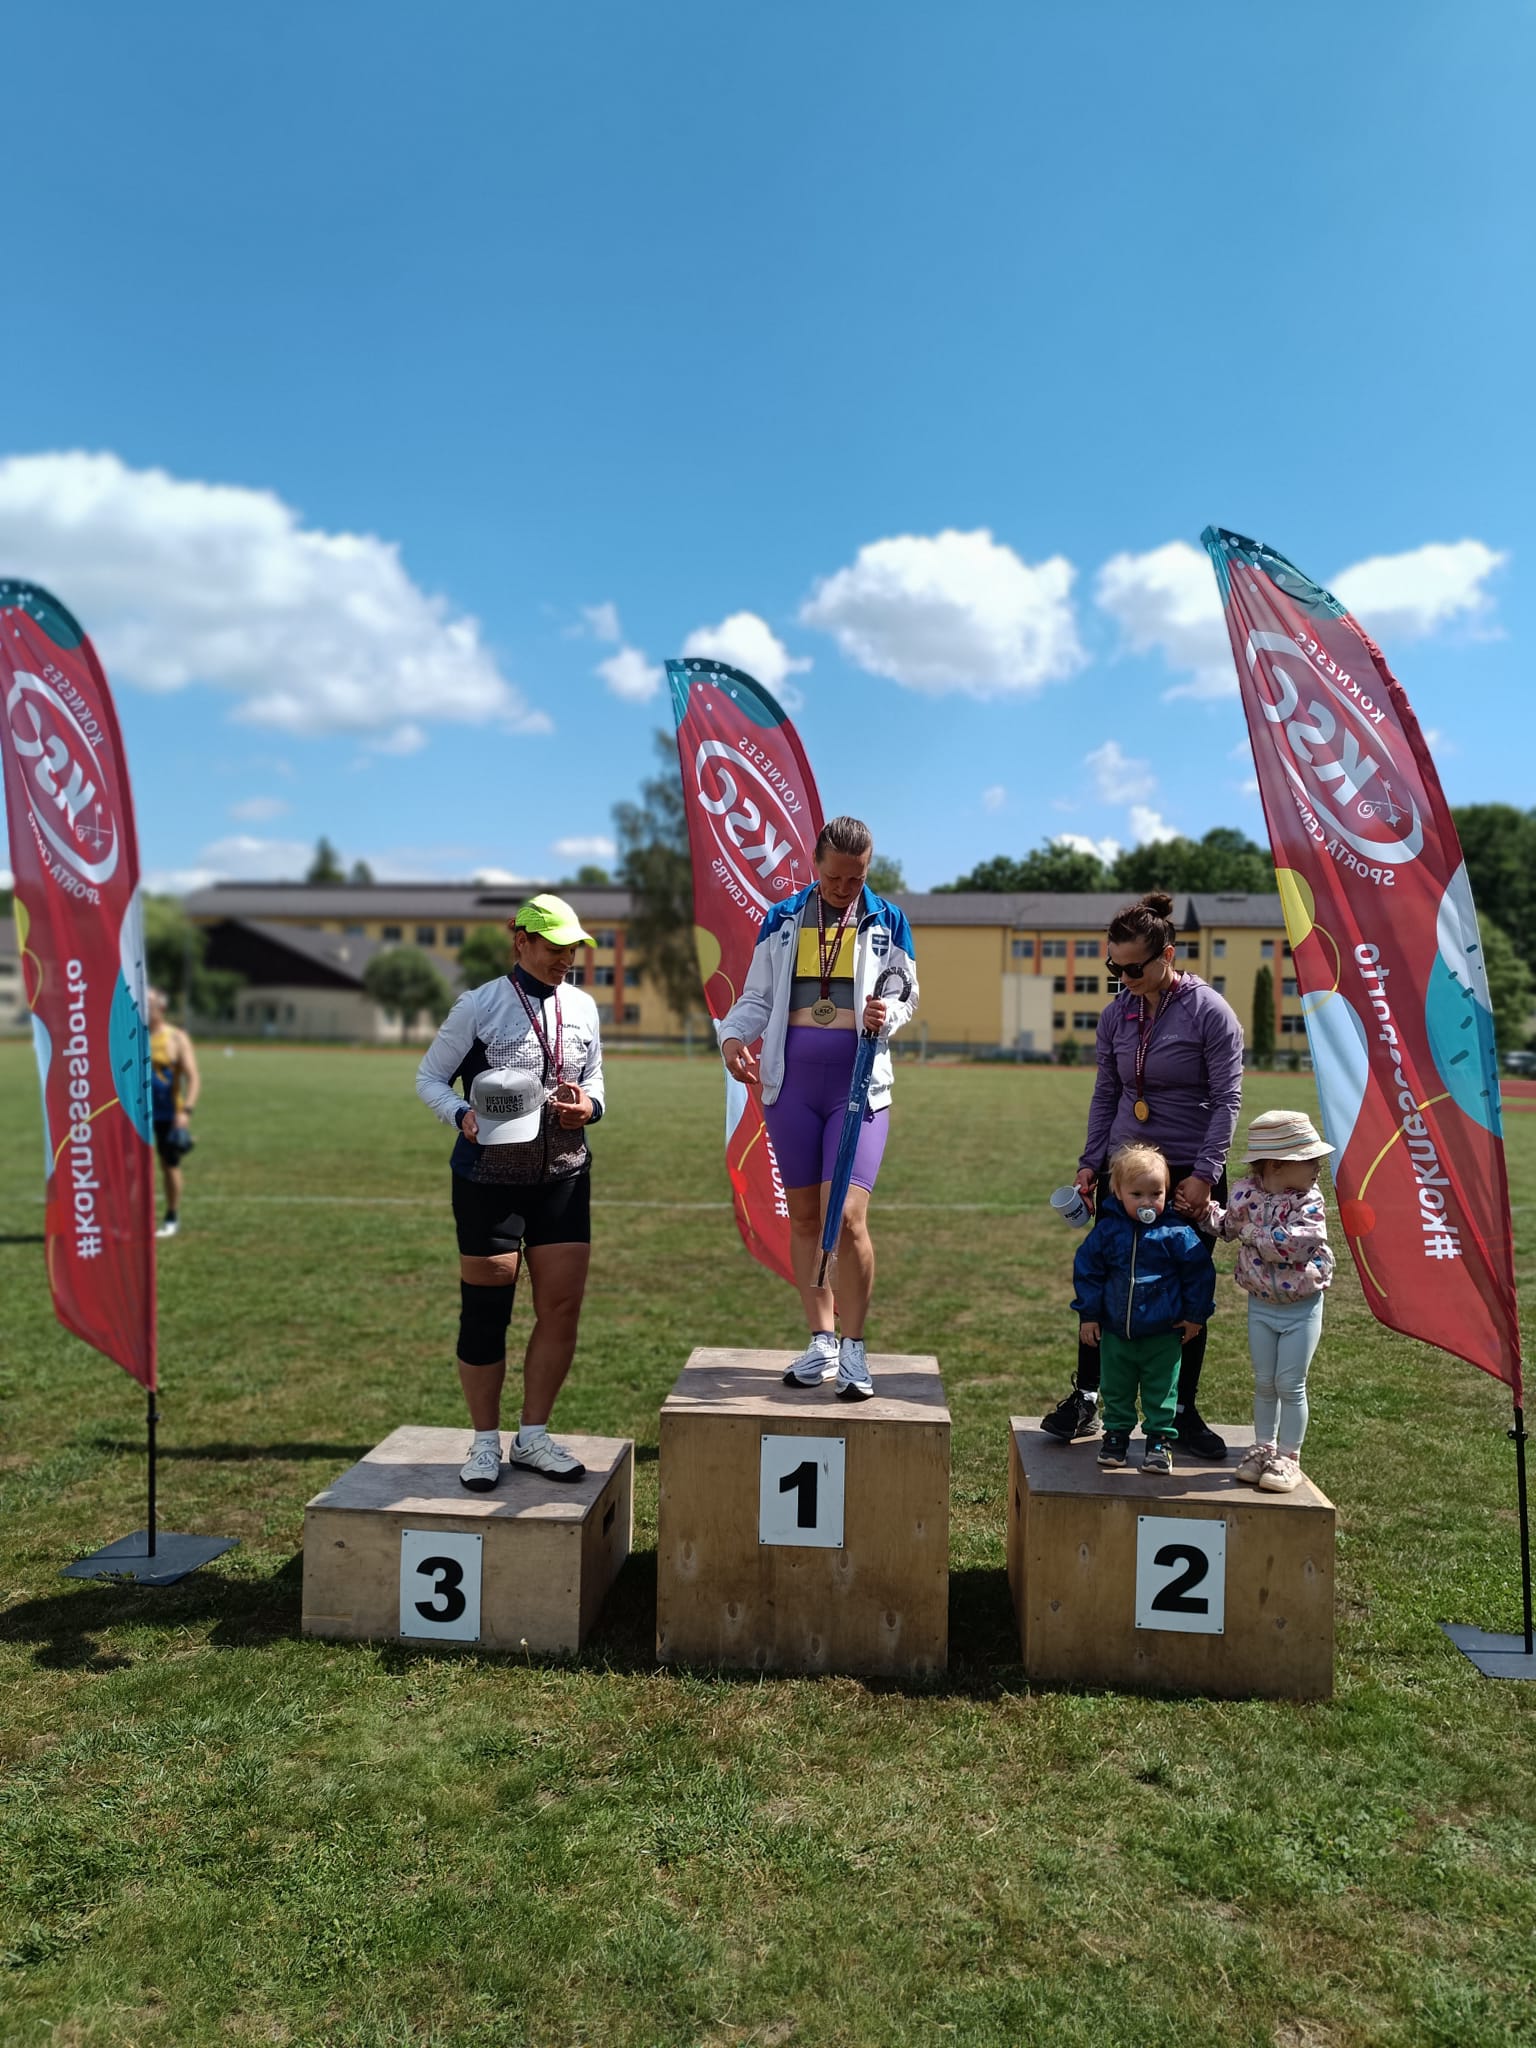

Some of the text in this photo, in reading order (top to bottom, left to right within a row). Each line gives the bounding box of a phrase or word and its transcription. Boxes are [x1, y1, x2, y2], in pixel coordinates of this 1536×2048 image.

[486, 1104, 518, 1113] KAUSS
[780, 1462, 817, 1528] 1
[415, 1557, 465, 1622] 3
[1151, 1544, 1208, 1614] 2
